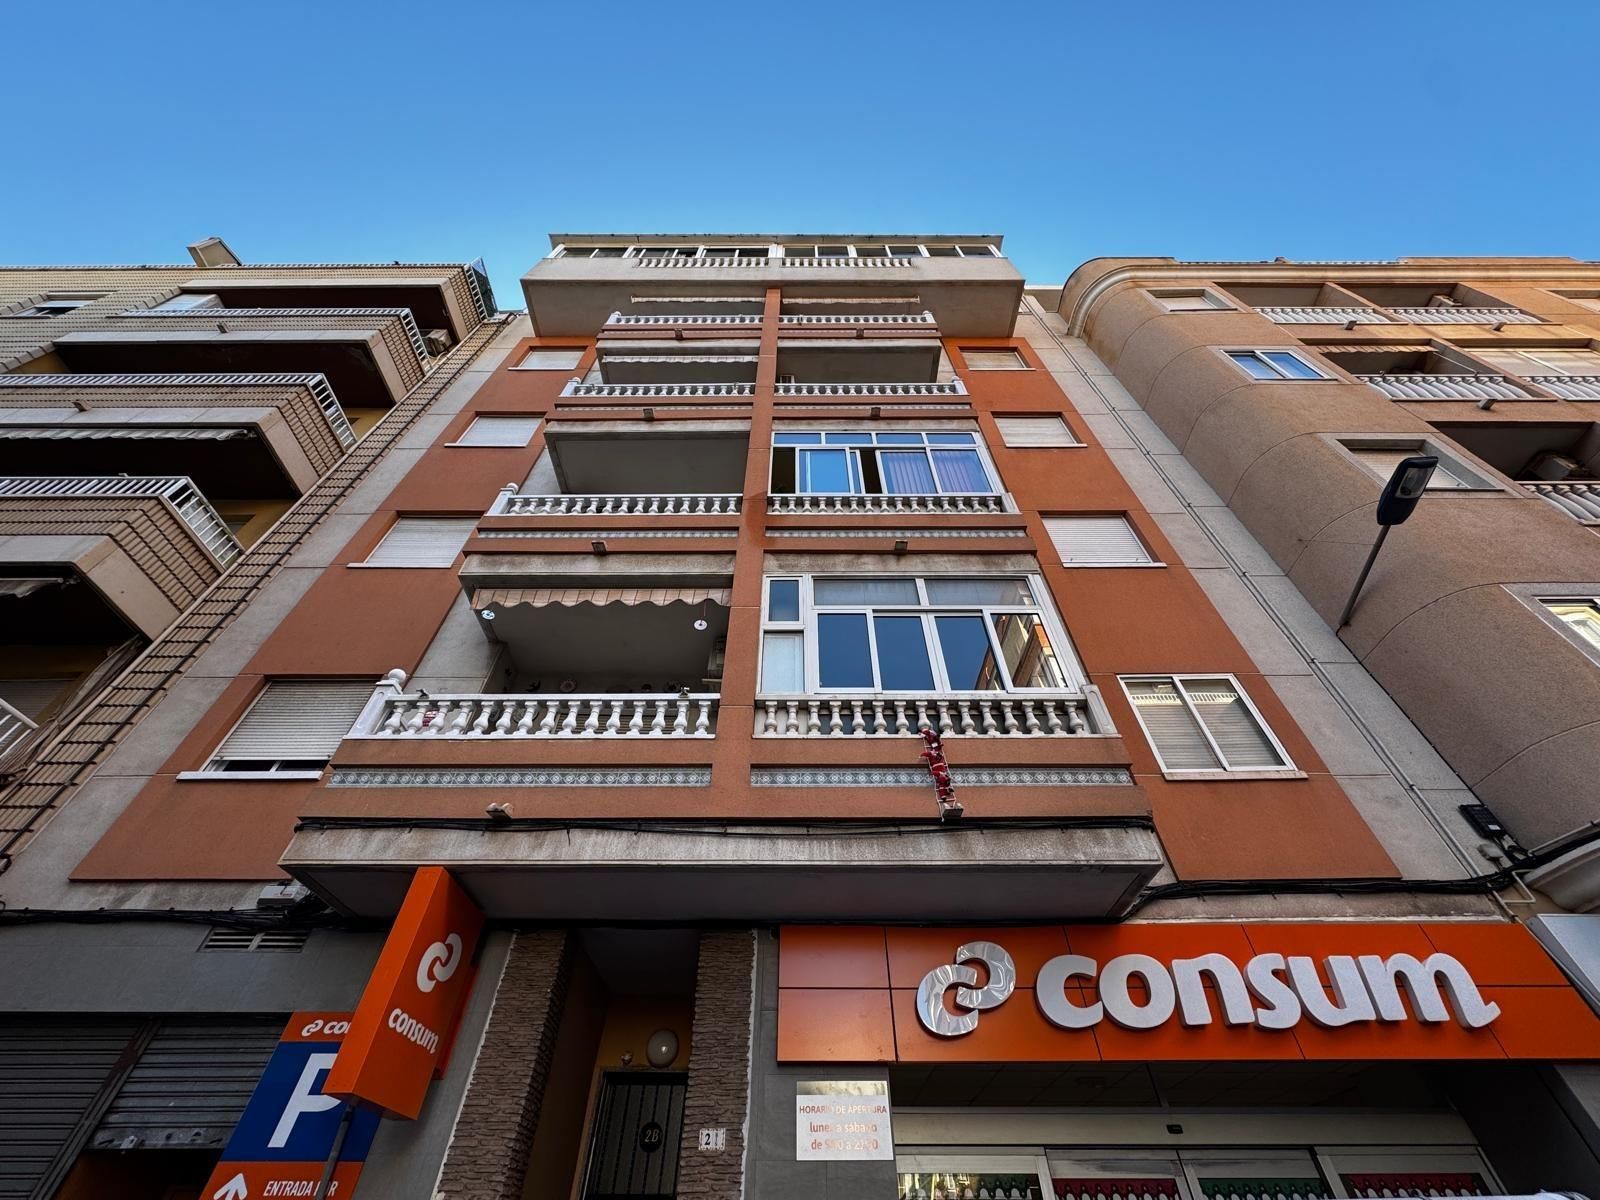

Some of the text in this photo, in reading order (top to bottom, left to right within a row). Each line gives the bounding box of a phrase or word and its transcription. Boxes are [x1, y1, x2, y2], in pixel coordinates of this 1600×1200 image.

[1035, 952, 1501, 1031] consum
[387, 1007, 440, 1055] consum
[836, 1105, 847, 1114] DE
[811, 1139, 823, 1150] de
[263, 1180, 314, 1197] ENTRADA
